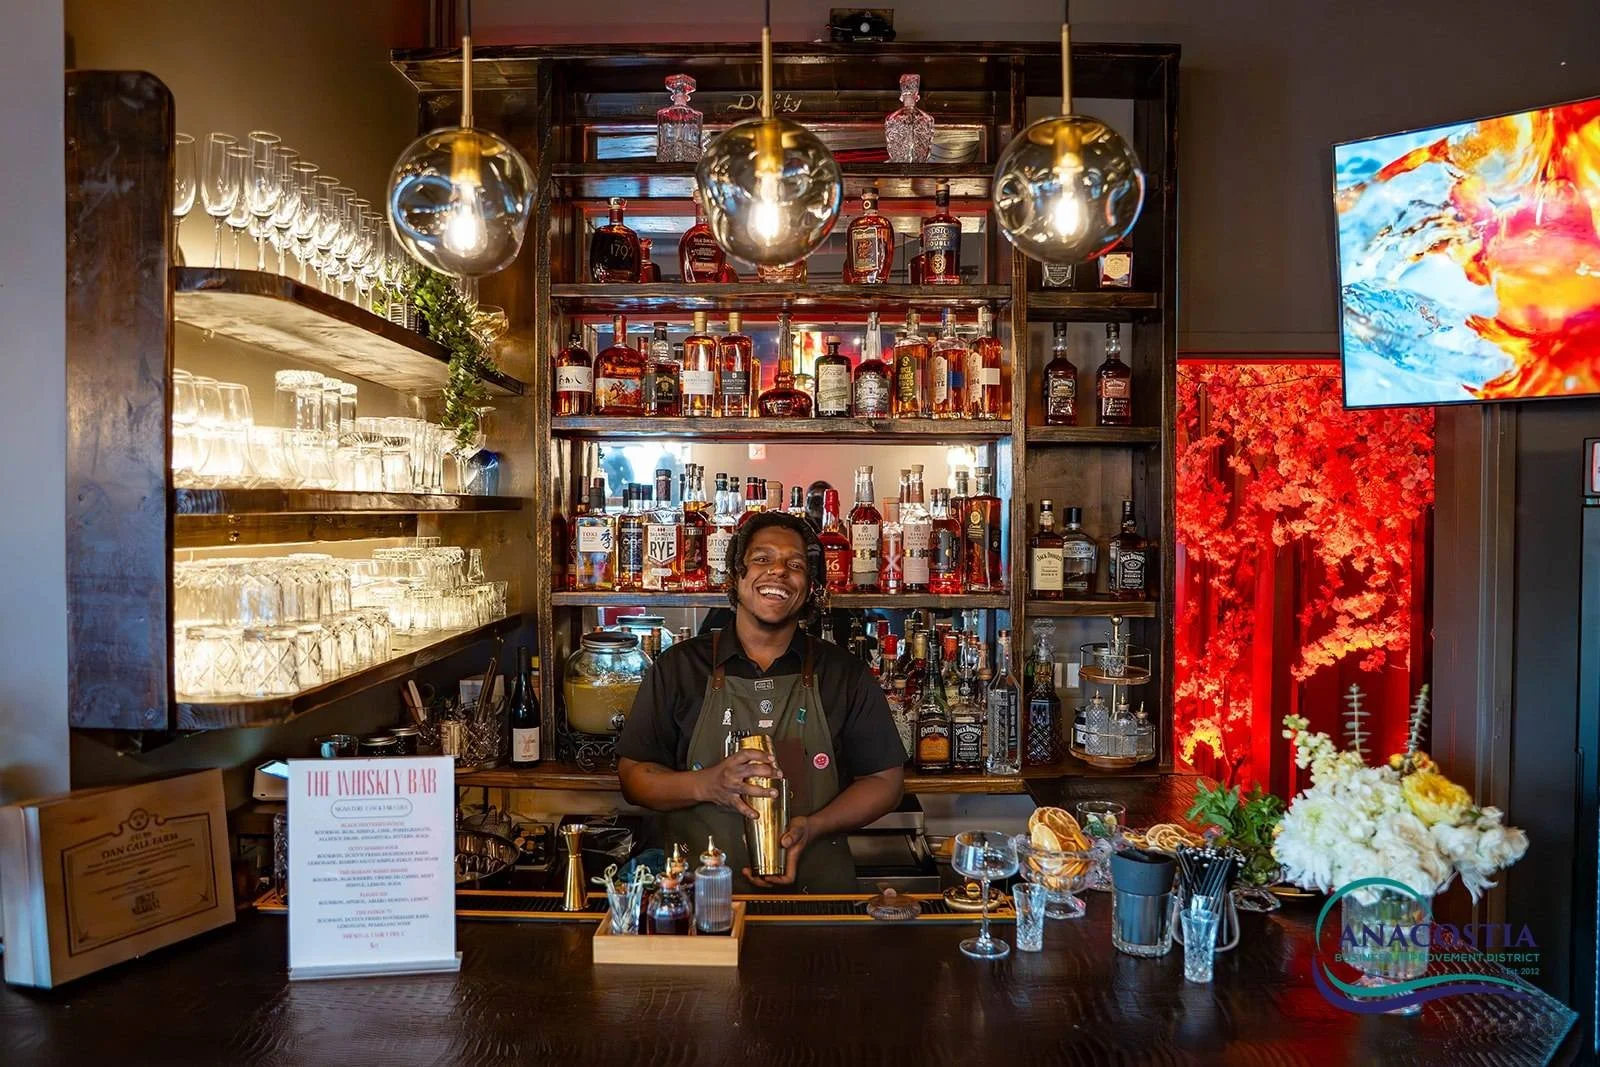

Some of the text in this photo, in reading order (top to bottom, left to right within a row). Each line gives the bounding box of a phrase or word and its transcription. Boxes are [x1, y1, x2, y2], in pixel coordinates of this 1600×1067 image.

[650, 541, 675, 560] RYE
[306, 767, 437, 797] THE WHISKEY BAR
[102, 846, 125, 859] DAN
